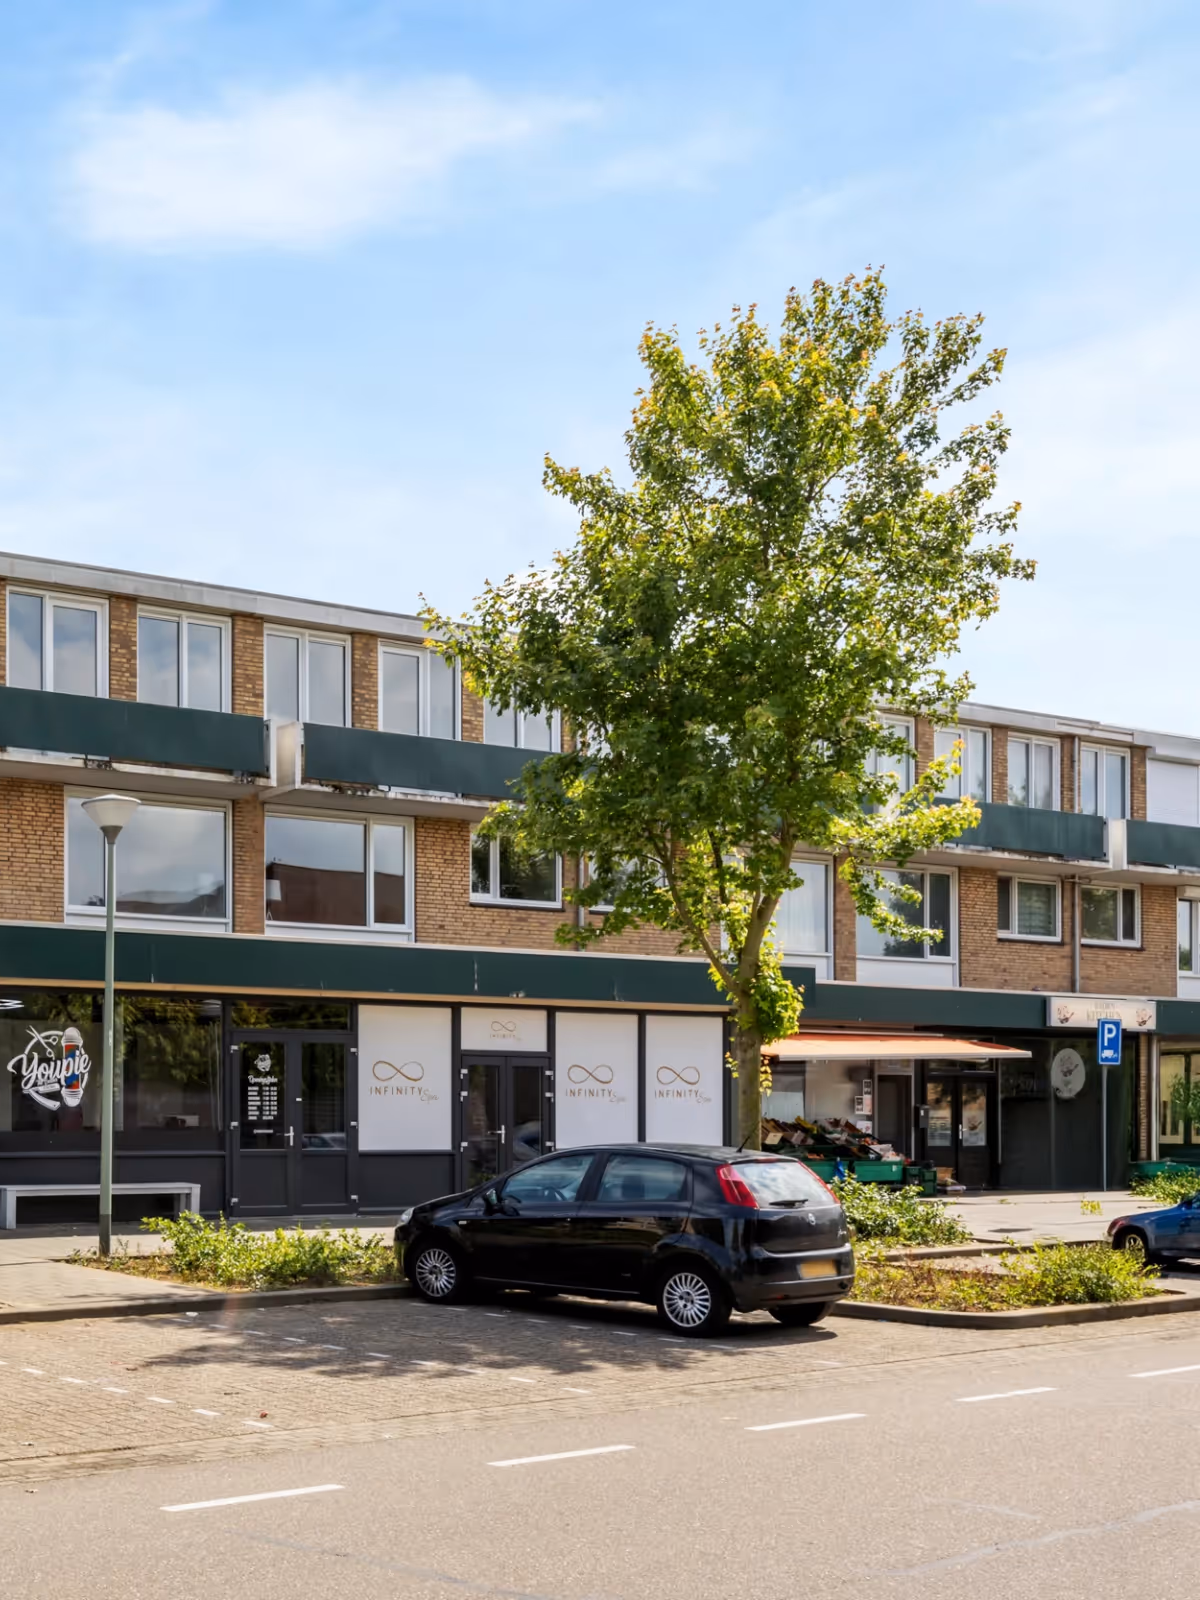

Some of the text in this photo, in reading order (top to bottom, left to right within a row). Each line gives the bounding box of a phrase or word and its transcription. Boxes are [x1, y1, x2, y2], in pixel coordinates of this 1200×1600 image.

[1104, 1024, 1117, 1047] P
[7, 1047, 92, 1090] Youpie
[368, 1086, 423, 1096] INFINITY
[565, 1088, 613, 1098] INFINITY
[654, 1089, 699, 1099] INFINITY
